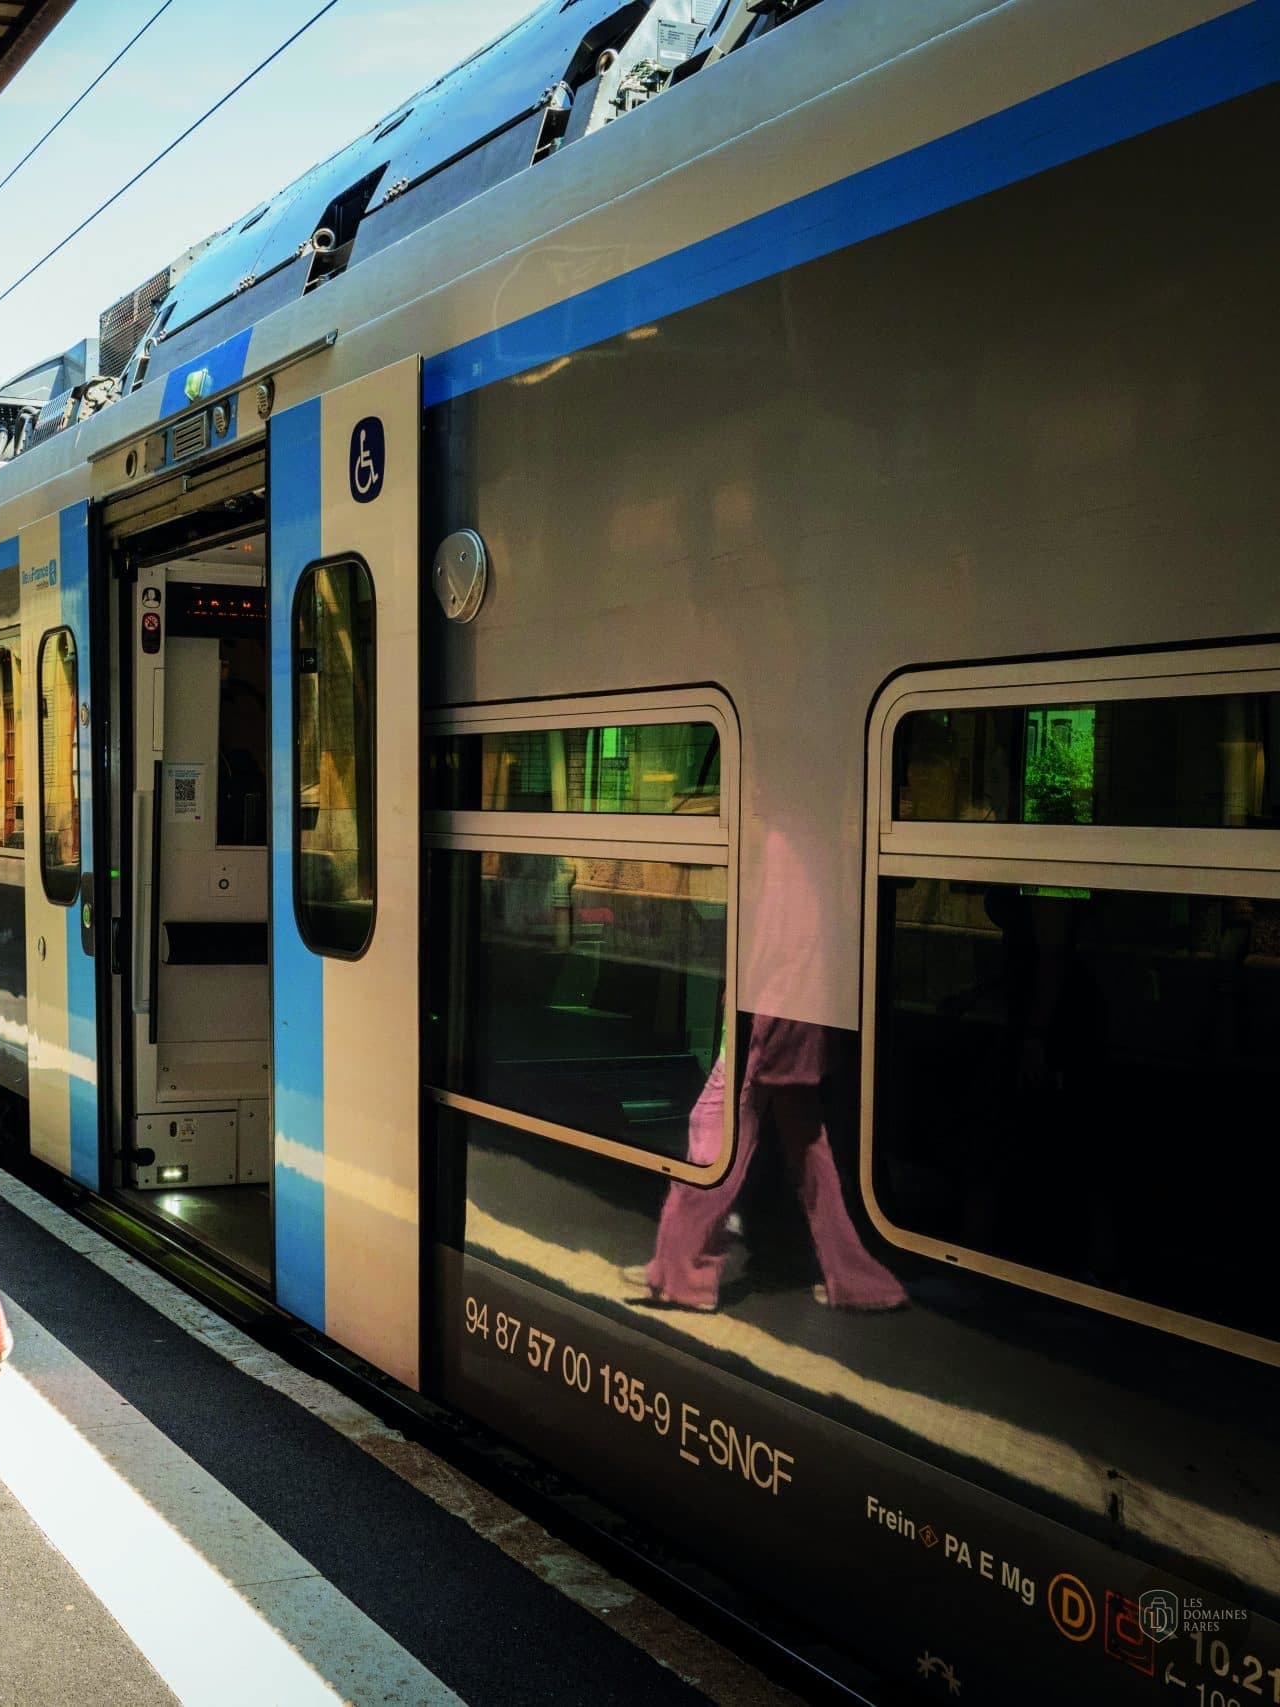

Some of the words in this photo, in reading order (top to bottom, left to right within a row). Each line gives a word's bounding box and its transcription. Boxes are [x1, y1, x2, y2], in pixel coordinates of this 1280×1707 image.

[465, 1297, 489, 1340] 94
[495, 1312, 521, 1354] 87
[527, 1327, 556, 1372] 57
[562, 1345, 591, 1393] 00
[600, 1364, 670, 1436] 135-9
[866, 1496, 916, 1540] Frein
[945, 1533, 972, 1569] PA
[979, 1550, 994, 1580] E
[1001, 1561, 1036, 1607] Mg
[1062, 1587, 1087, 1630] D
